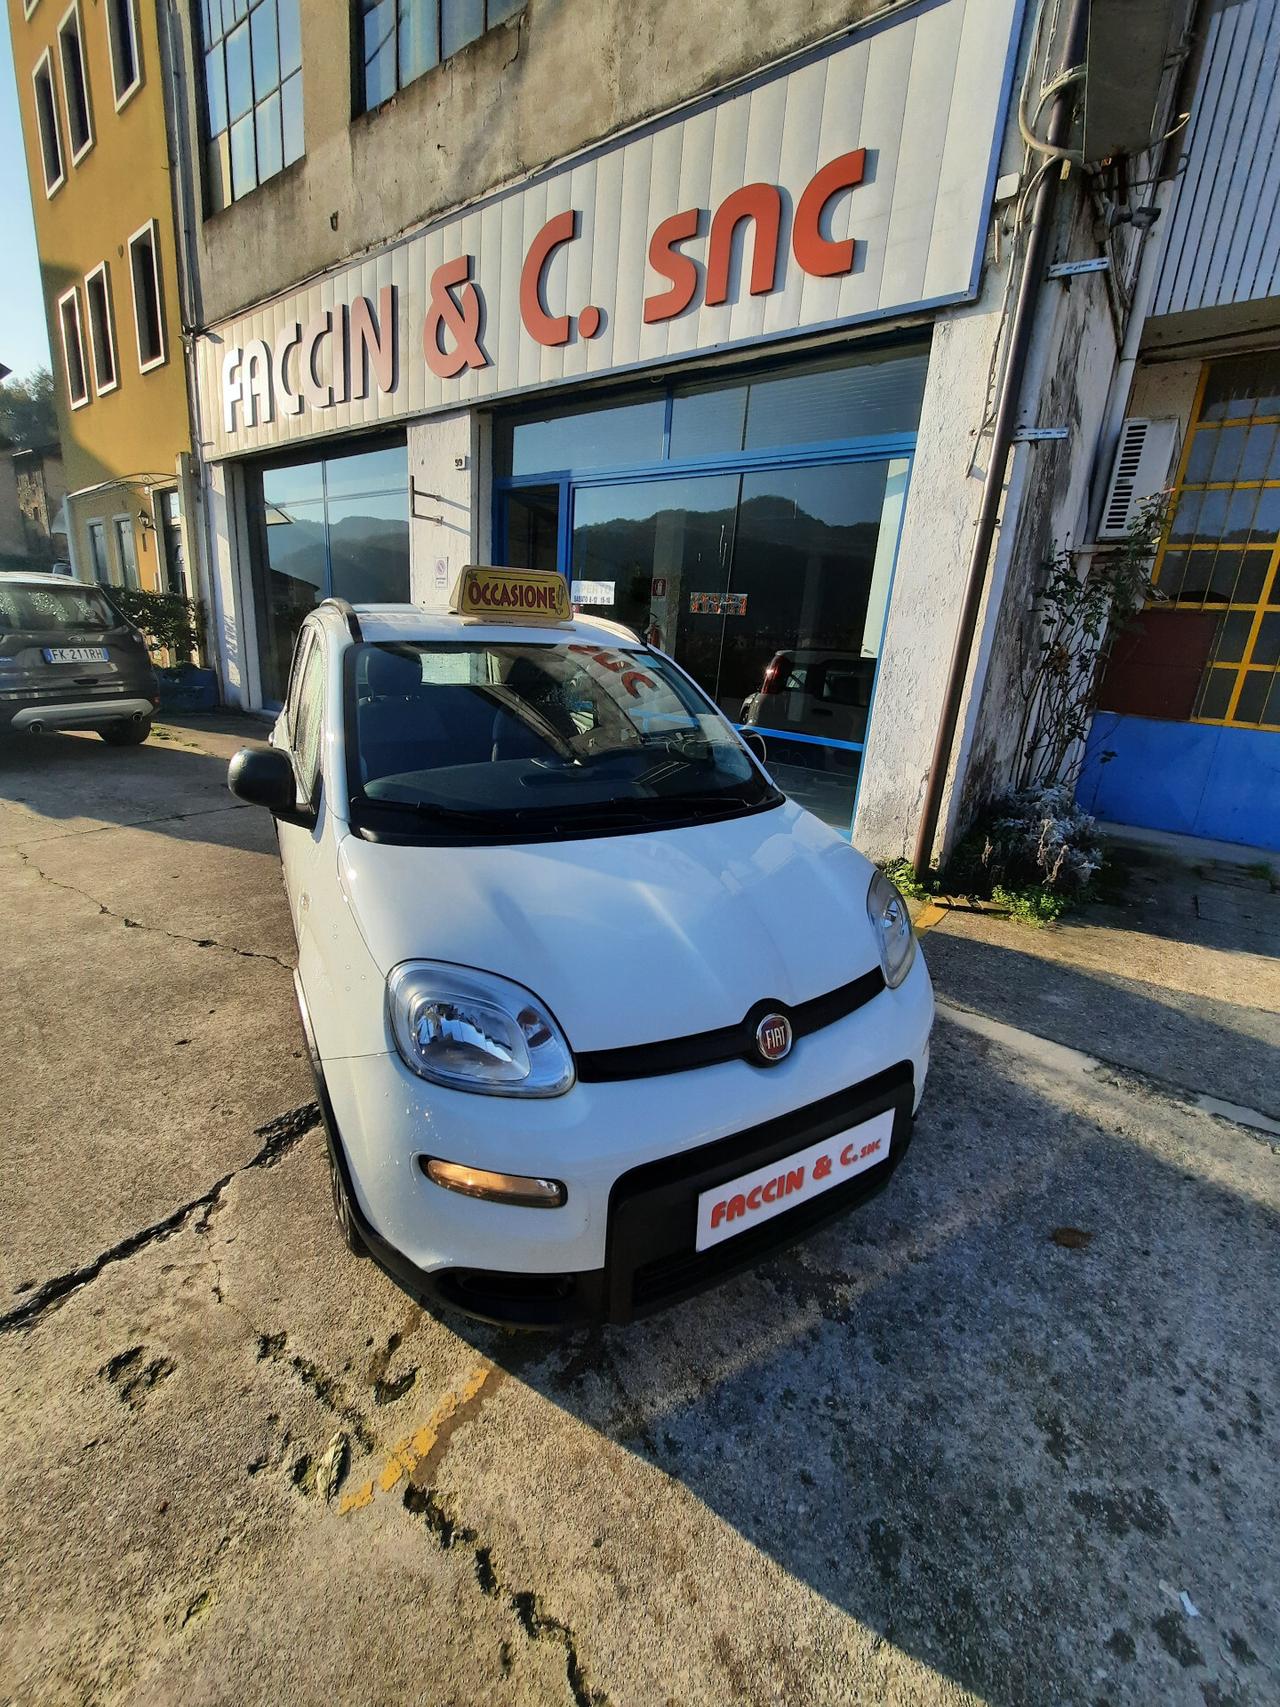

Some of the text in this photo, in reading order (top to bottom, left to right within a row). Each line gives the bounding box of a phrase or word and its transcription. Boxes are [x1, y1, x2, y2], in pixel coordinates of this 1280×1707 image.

[222, 284, 398, 433] FACCIN
[423, 255, 488, 379] &
[519, 209, 602, 346] C.
[765, 1026, 786, 1050] FIAT
[710, 1166, 805, 1229] FACCIN
[812, 1154, 832, 1180] &
